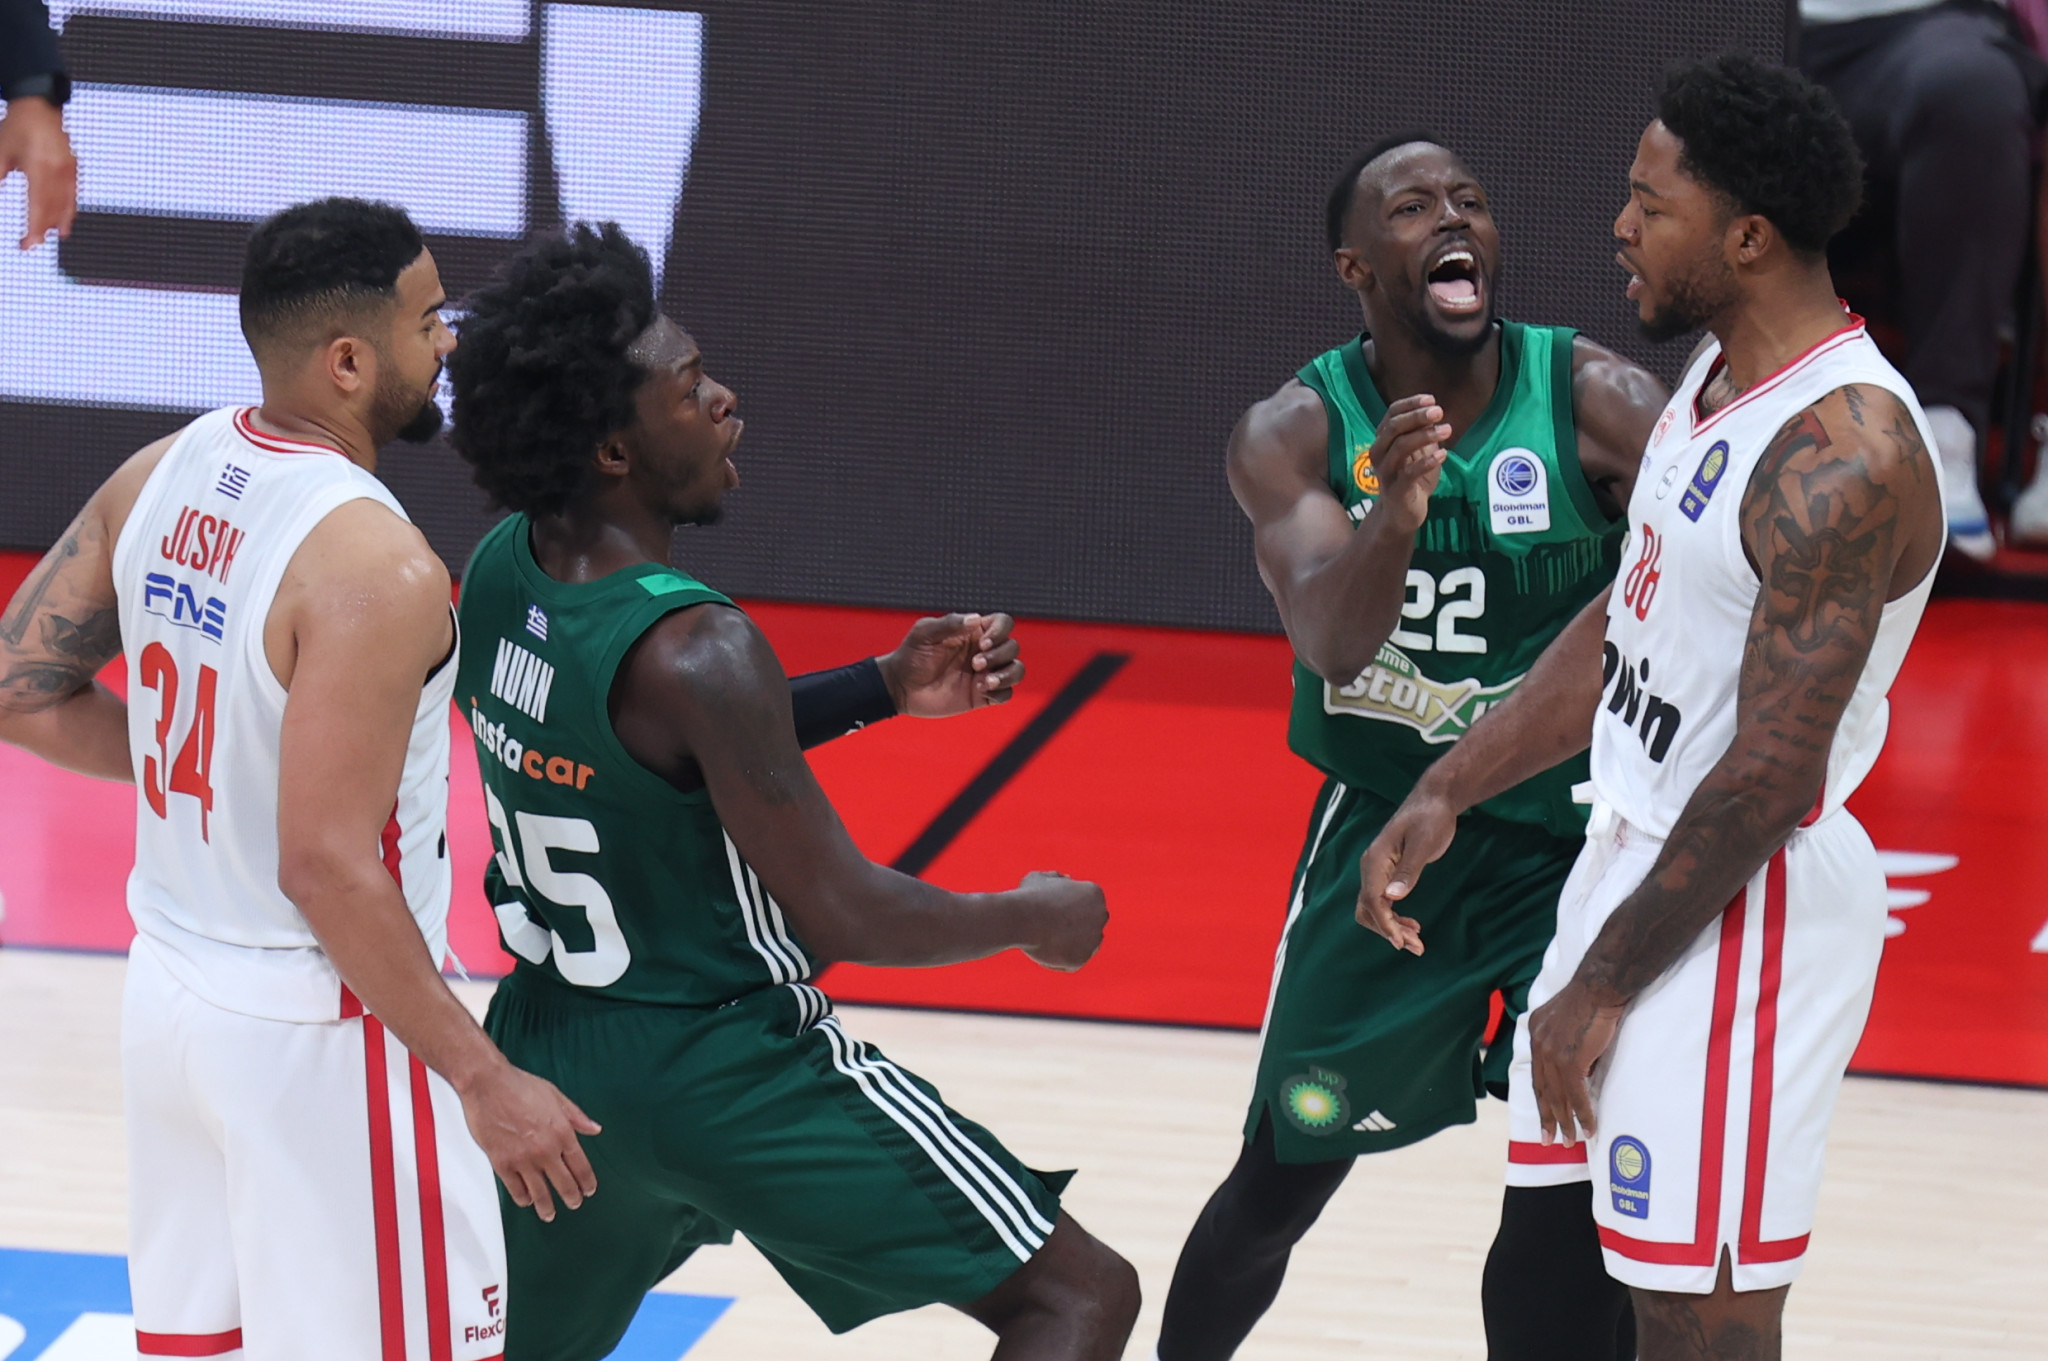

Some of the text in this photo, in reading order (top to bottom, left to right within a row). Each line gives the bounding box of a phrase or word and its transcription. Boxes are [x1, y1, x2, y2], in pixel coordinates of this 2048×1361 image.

[1507, 516, 1534, 525] GBL
[1389, 567, 1487, 654] 22
[490, 636, 554, 724] NUNN
[140, 641, 218, 846] 34
[471, 696, 596, 791] instacar
[1318, 1070, 1339, 1086] bp
[465, 1318, 506, 1343] FlexC
